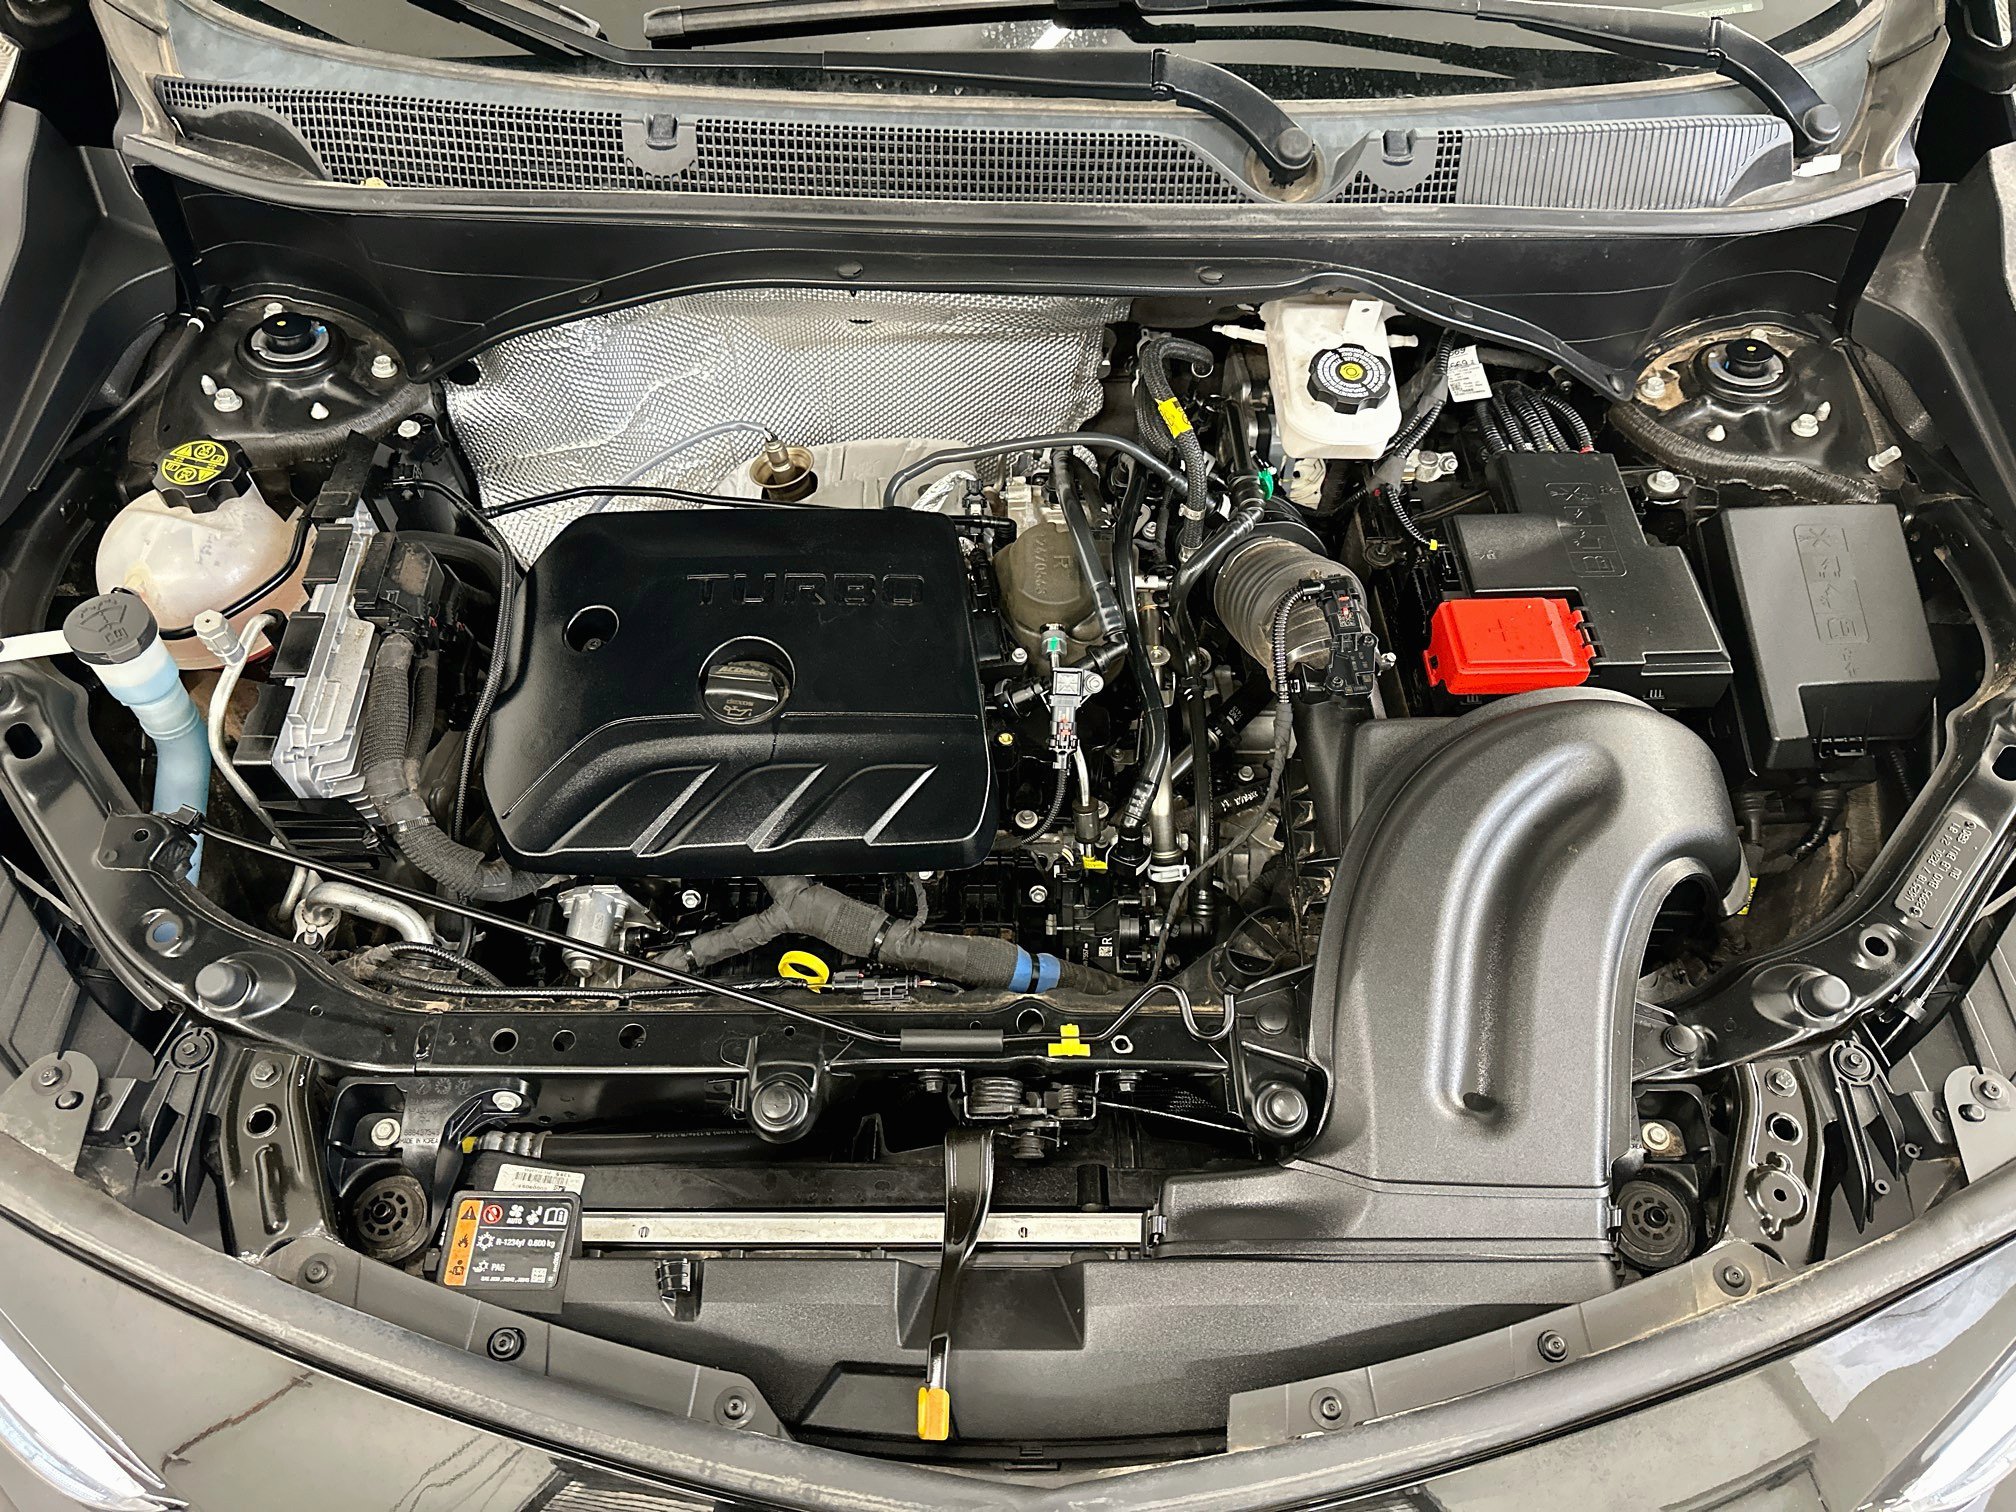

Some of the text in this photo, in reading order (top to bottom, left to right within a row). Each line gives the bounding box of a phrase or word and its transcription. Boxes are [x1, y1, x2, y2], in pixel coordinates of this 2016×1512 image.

[686, 573, 925, 606] TURBO
[715, 665, 769, 677] ACDelco
[726, 698, 754, 707] dexos
[1101, 937, 1113, 945] R
[506, 1217, 523, 1225] AUTO
[495, 1238, 526, 1248] R-1234yf
[546, 1239, 556, 1249] kg
[490, 1263, 506, 1272] PAG
